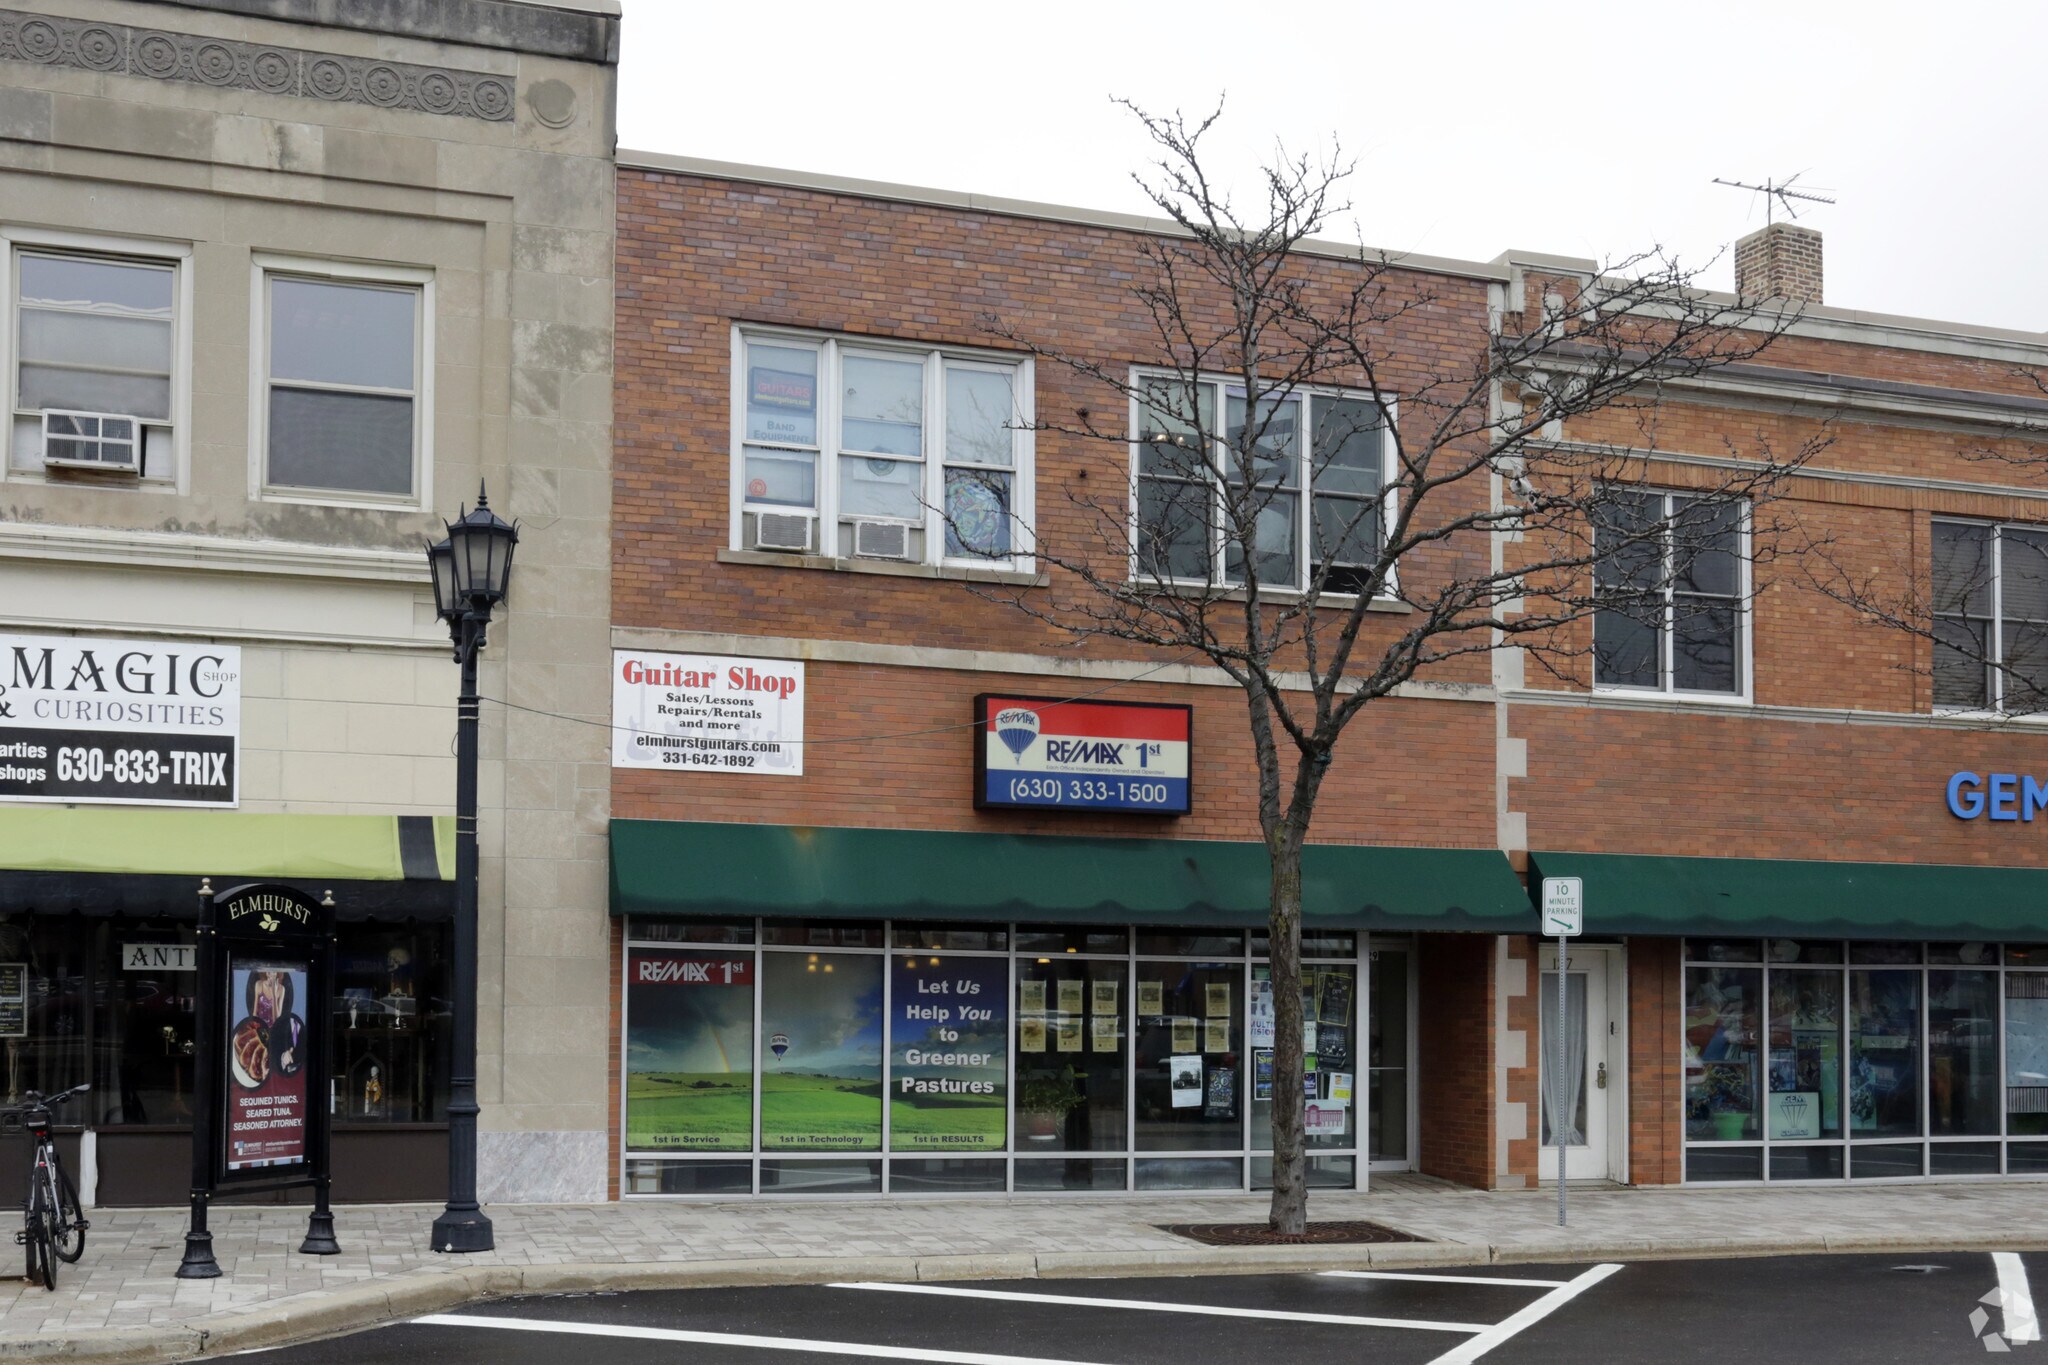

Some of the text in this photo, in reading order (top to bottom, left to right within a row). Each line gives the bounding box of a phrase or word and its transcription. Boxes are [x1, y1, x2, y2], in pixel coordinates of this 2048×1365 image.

[758, 382, 810, 398] GUITARS
[767, 420, 796, 431] BAND
[11, 646, 225, 698] MAGIC
[203, 671, 237, 682] SHOP
[622, 659, 796, 699] Guitar Shop
[666, 692, 754, 707] Sales/Lessons
[34, 698, 224, 726] CURIOSITIES
[657, 704, 762, 720] Repairs/Rentals
[1000, 711, 1035, 726] RE/MAX
[679, 719, 741, 731] and more
[636, 735, 781, 754] elmhurstguitars.com
[663, 752, 755, 768] 331-642-1892
[1046, 740, 1161, 768] RE/MAX 1st
[0, 764, 47, 784] shops
[57, 746, 227, 786] 630-833-TRIX
[1010, 777, 1167, 804] (630) 333-1500
[1946, 770, 2048, 822] GEM
[1556, 884, 1569, 895] 10
[228, 894, 311, 925] ELMHURST
[1549, 897, 1575, 906] MINUTE
[1546, 907, 1578, 915] PARKING
[1553, 957, 1573, 969] 17
[639, 961, 745, 984] RE/MAX 1st
[918, 979, 981, 995] Let Us
[906, 1005, 992, 1023] Help You
[939, 1028, 959, 1042] to
[905, 1049, 991, 1066] Greener
[901, 1076, 995, 1094] Pastures
[240, 1095, 298, 1106] SEQUINED TUNICS.
[246, 1107, 292, 1118] SEARED TUNA.
[233, 1118, 302, 1131] SEASONED ATTORNEY.
[653, 1135, 720, 1143] 1st in Service
[779, 1135, 864, 1144] 1st in Technology
[913, 1135, 985, 1143] 1st in RESULTS
